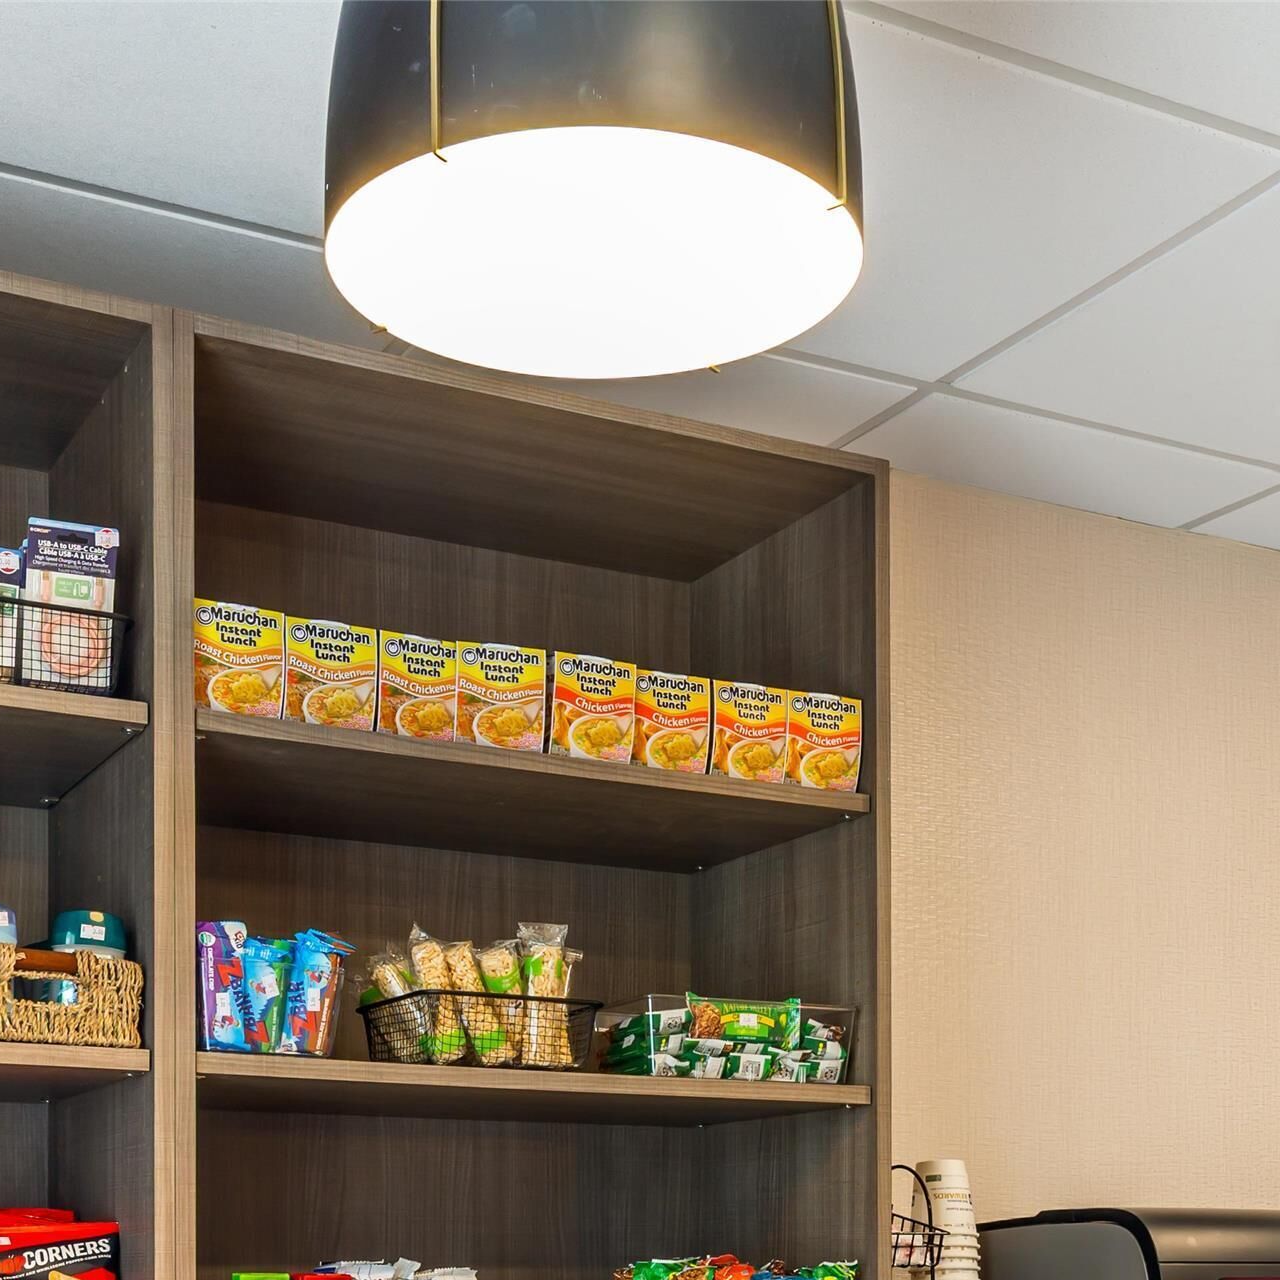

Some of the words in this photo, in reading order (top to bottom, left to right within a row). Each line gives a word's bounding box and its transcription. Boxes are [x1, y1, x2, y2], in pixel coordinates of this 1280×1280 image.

[38, 540, 59, 549] USB-A
[68, 543, 88, 552] USB-C
[89, 546, 108, 555] Cable
[58, 550, 79, 559] USB-A
[85, 553, 106, 562] USB-C
[210, 604, 279, 630] Maruchan
[215, 621, 262, 638] Instant
[305, 624, 371, 646] Maruchan
[220, 633, 257, 647] Lunch
[310, 638, 355, 655] Instant
[193, 638, 221, 660] Roast
[222, 651, 263, 666] Chicken
[315, 649, 351, 664] Lunch
[475, 646, 539, 666] Maruchan
[289, 655, 318, 676] Roast
[318, 666, 356, 681] Chicken
[402, 652, 446, 669] Instant
[480, 661, 524, 676] Instant
[573, 657, 631, 680] Maruchan
[407, 663, 441, 678] Lunch
[485, 671, 520, 685] Lunch
[382, 669, 409, 688] Roast
[409, 679, 446, 694] Chicken
[576, 672, 617, 688] Instant
[648, 674, 704, 694] Maruchan
[459, 677, 488, 695] Roast
[488, 687, 525, 702] Chicken
[580, 682, 612, 697] Lunch
[652, 689, 692, 704] Instant
[730, 686, 782, 705] Maruchan
[575, 697, 615, 713] Chicken
[656, 698, 688, 711] Lunch
[734, 699, 770, 714] Instant
[803, 695, 856, 714] Maruchan
[652, 712, 689, 727] Chicken
[737, 709, 767, 722] Lunch
[807, 709, 843, 723] Instant
[734, 722, 769, 738] Chicken
[811, 718, 841, 731] Lunch
[807, 731, 842, 746] Chicken
